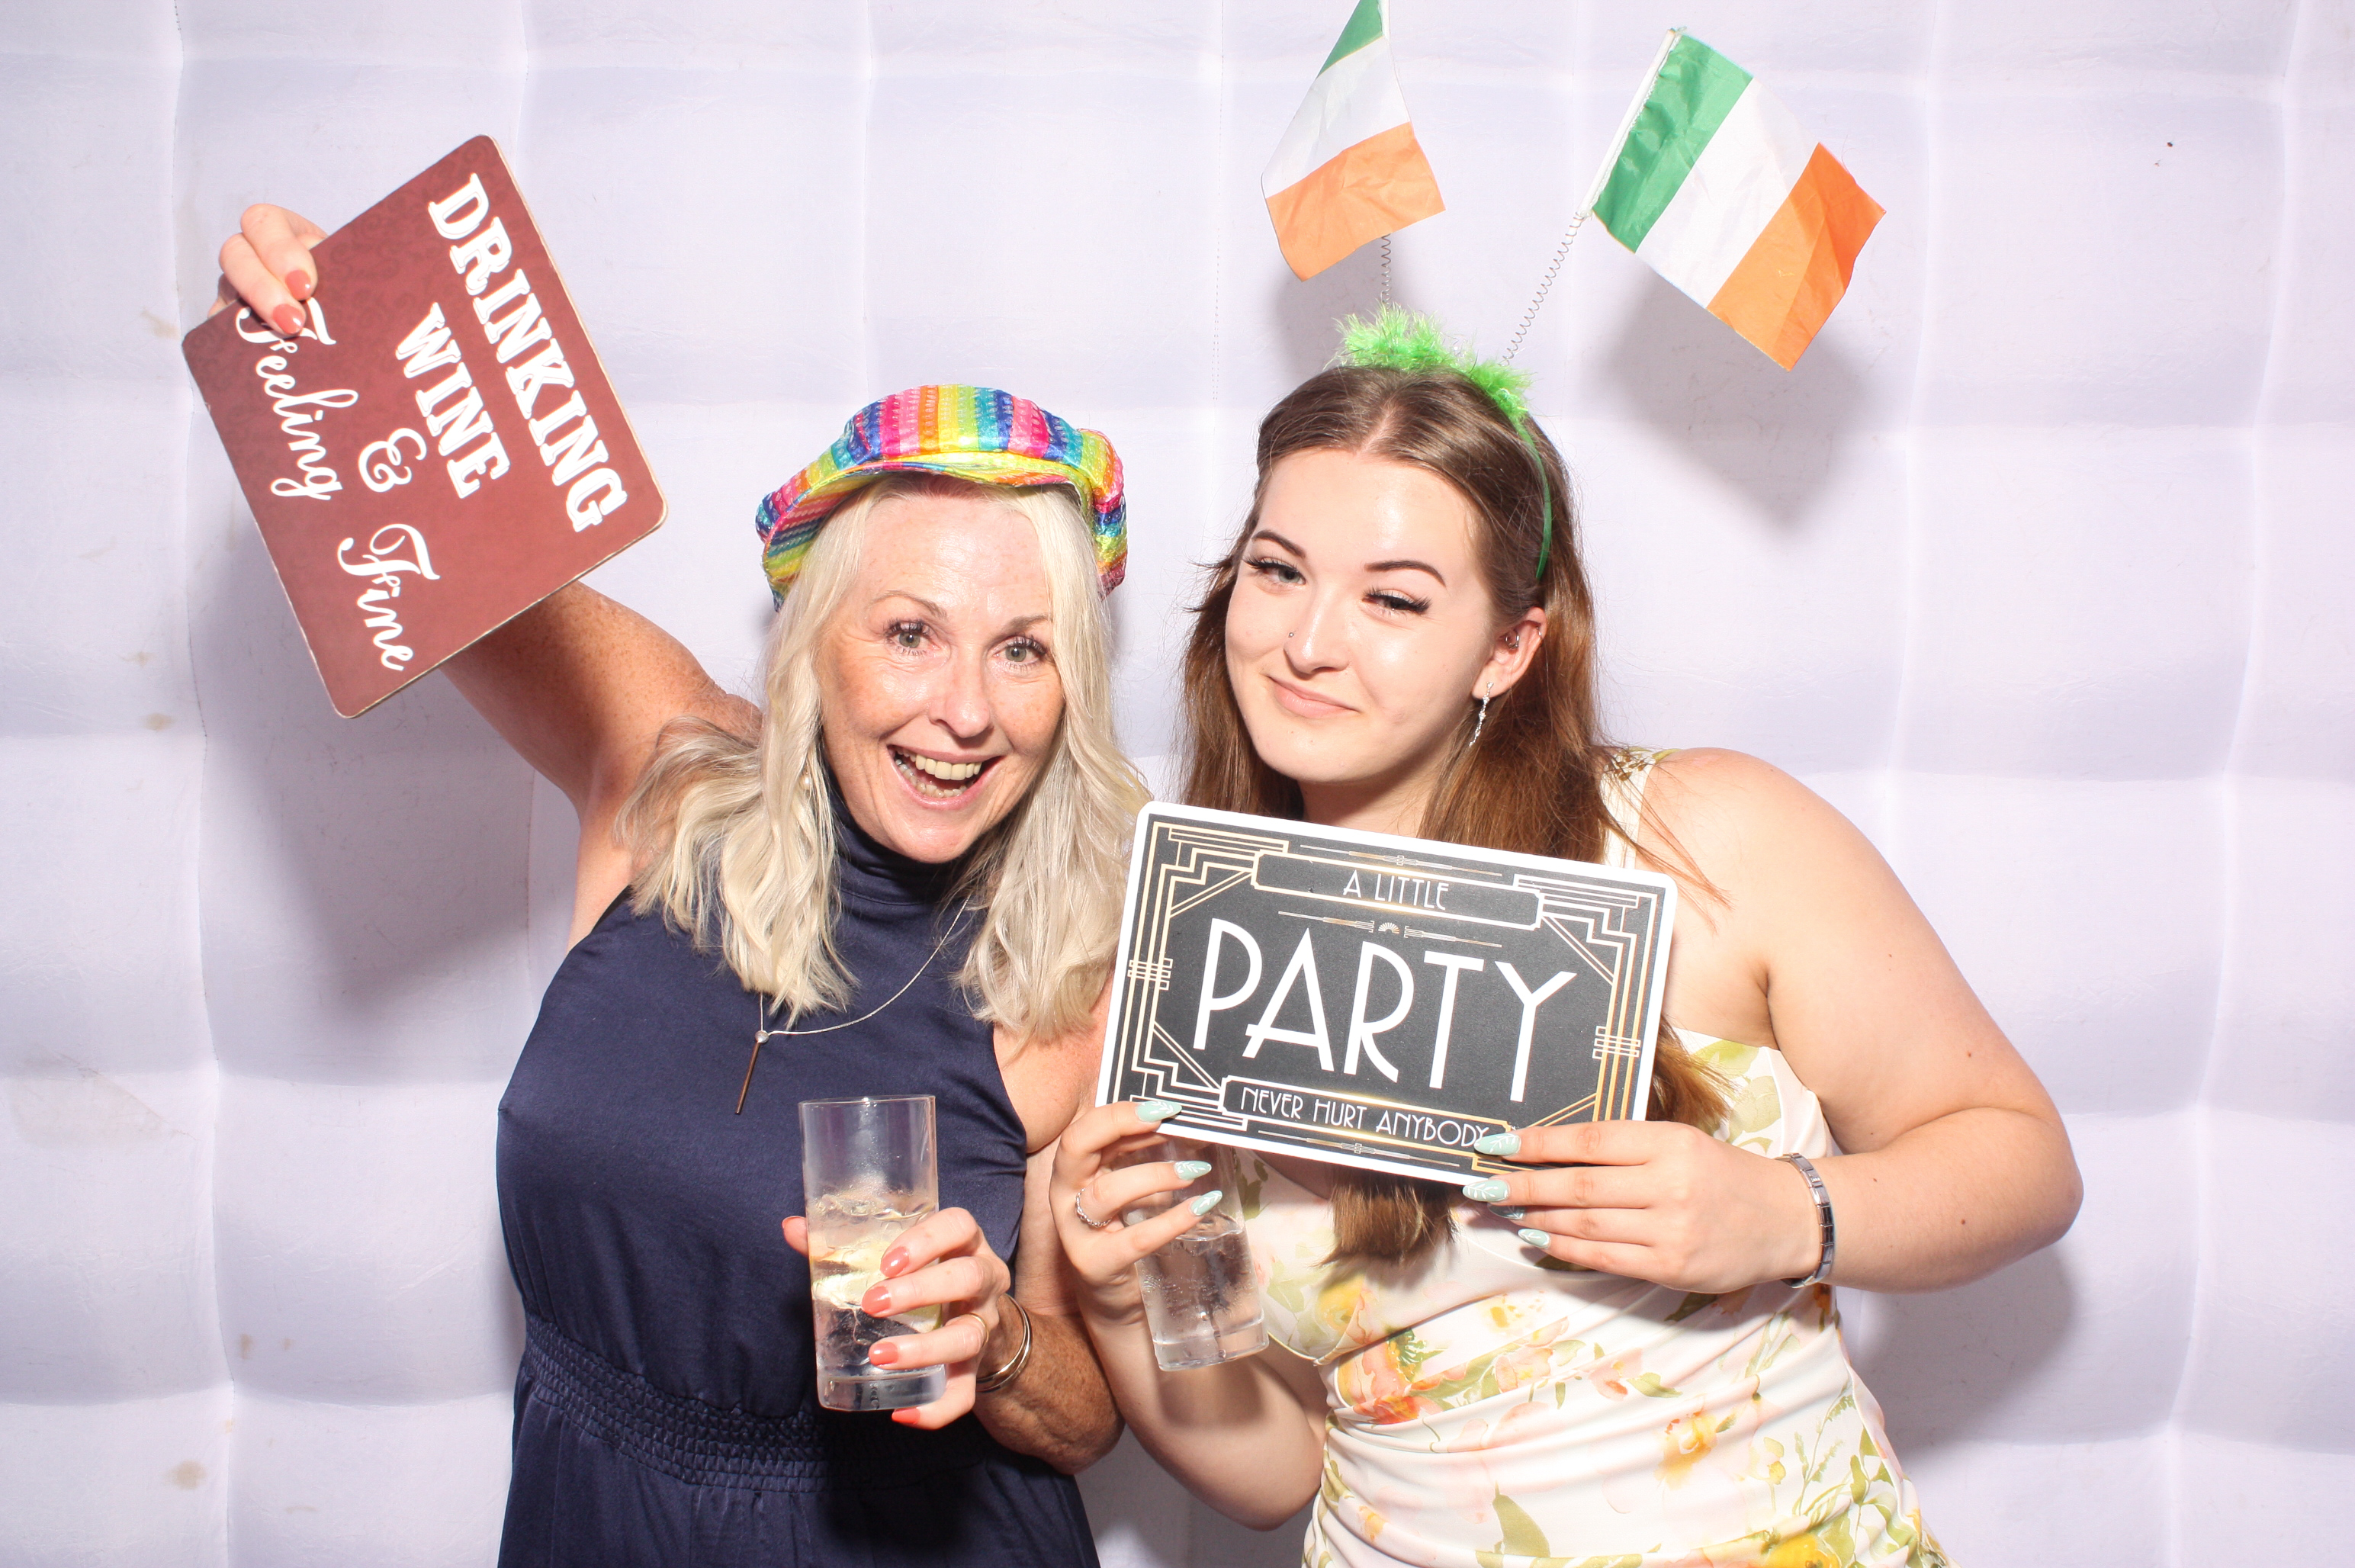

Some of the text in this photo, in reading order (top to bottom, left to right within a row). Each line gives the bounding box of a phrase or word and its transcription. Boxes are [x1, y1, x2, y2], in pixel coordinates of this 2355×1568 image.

[395, 302, 511, 500] WINE
[428, 172, 628, 532] DRINKING
[358, 428, 427, 493] &
[336, 523, 440, 671] Fine
[1342, 869, 1449, 911] A LITTLE
[1193, 917, 1577, 1103] PARTY
[1241, 1087, 1303, 1120] NEVER
[1312, 1099, 1367, 1129] HURT
